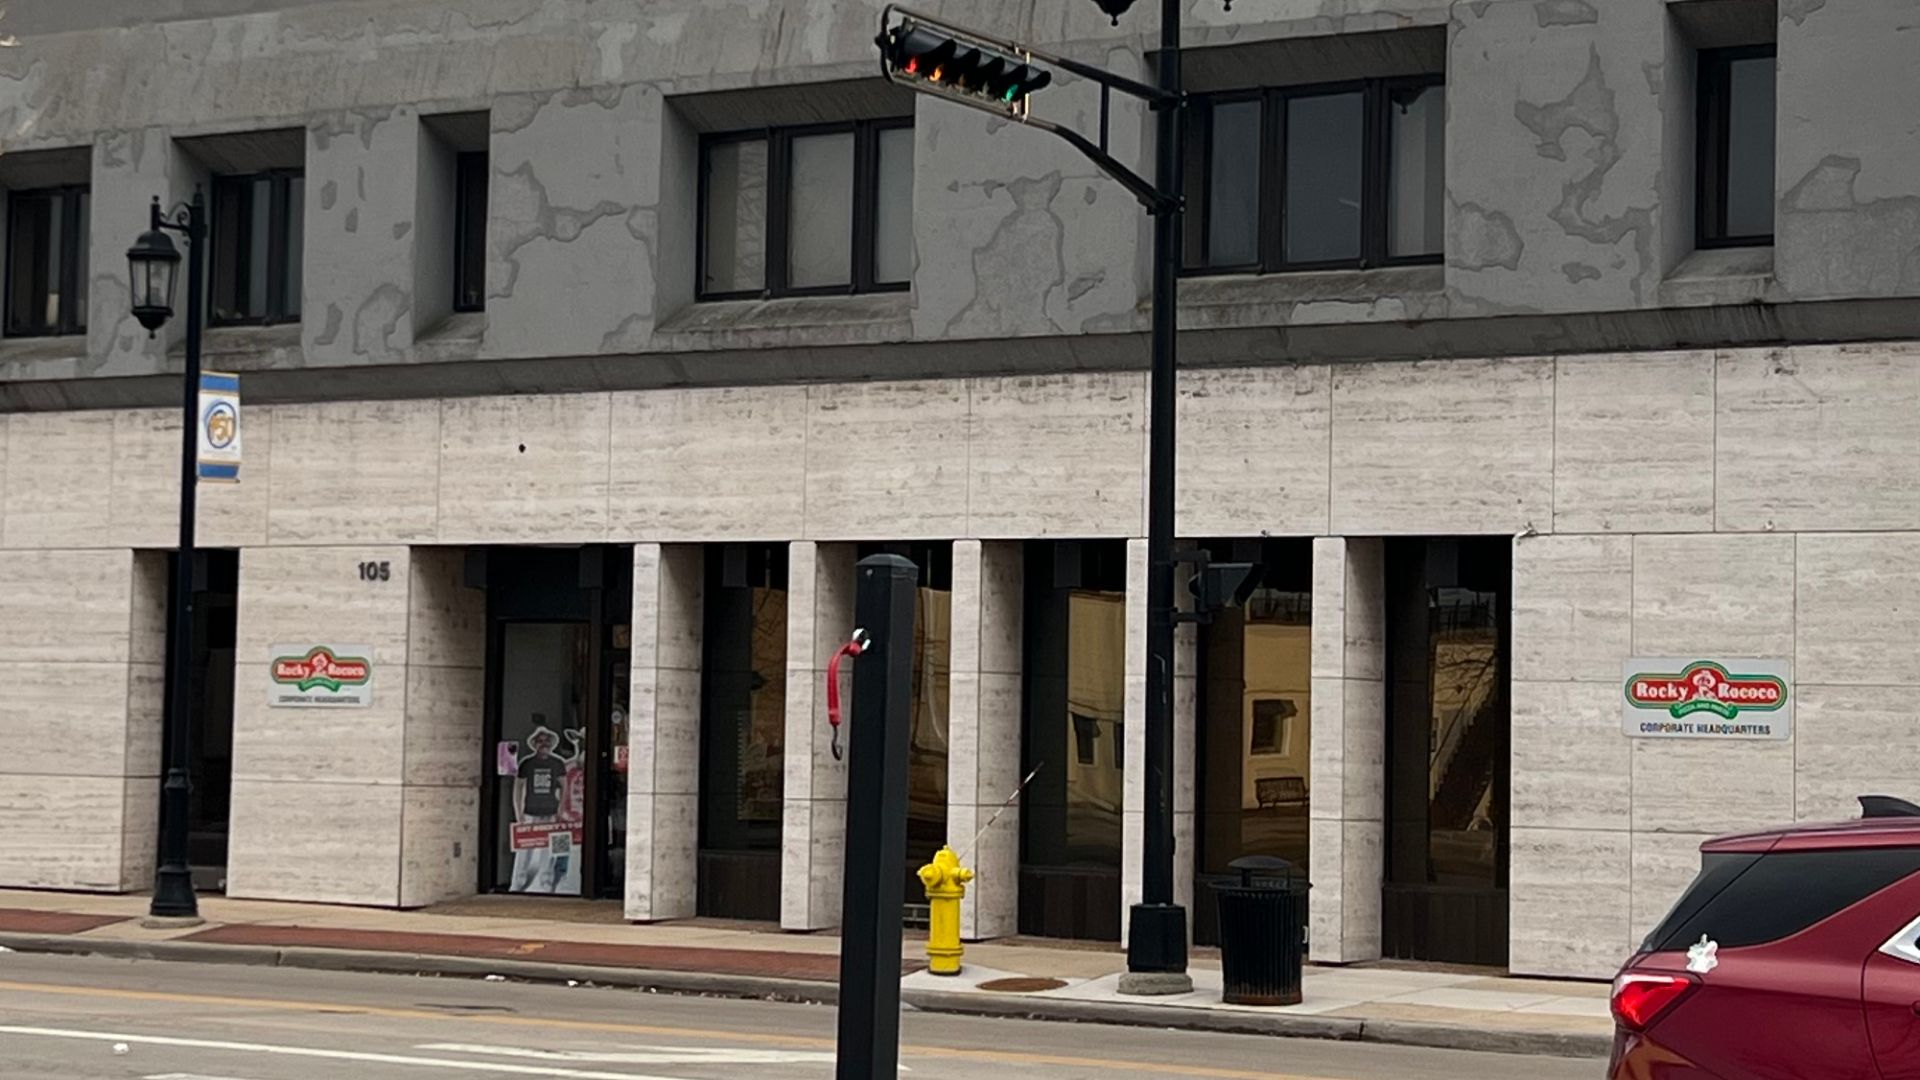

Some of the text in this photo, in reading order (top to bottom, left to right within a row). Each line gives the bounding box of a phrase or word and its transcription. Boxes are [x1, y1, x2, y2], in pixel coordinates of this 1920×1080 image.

[358, 561, 391, 581] 105
[277, 662, 366, 679] Rocky Rococo
[1636, 682, 1778, 700] Rocky Rococo
[1640, 722, 1771, 735] CORPORATE HEADQUARTERS
